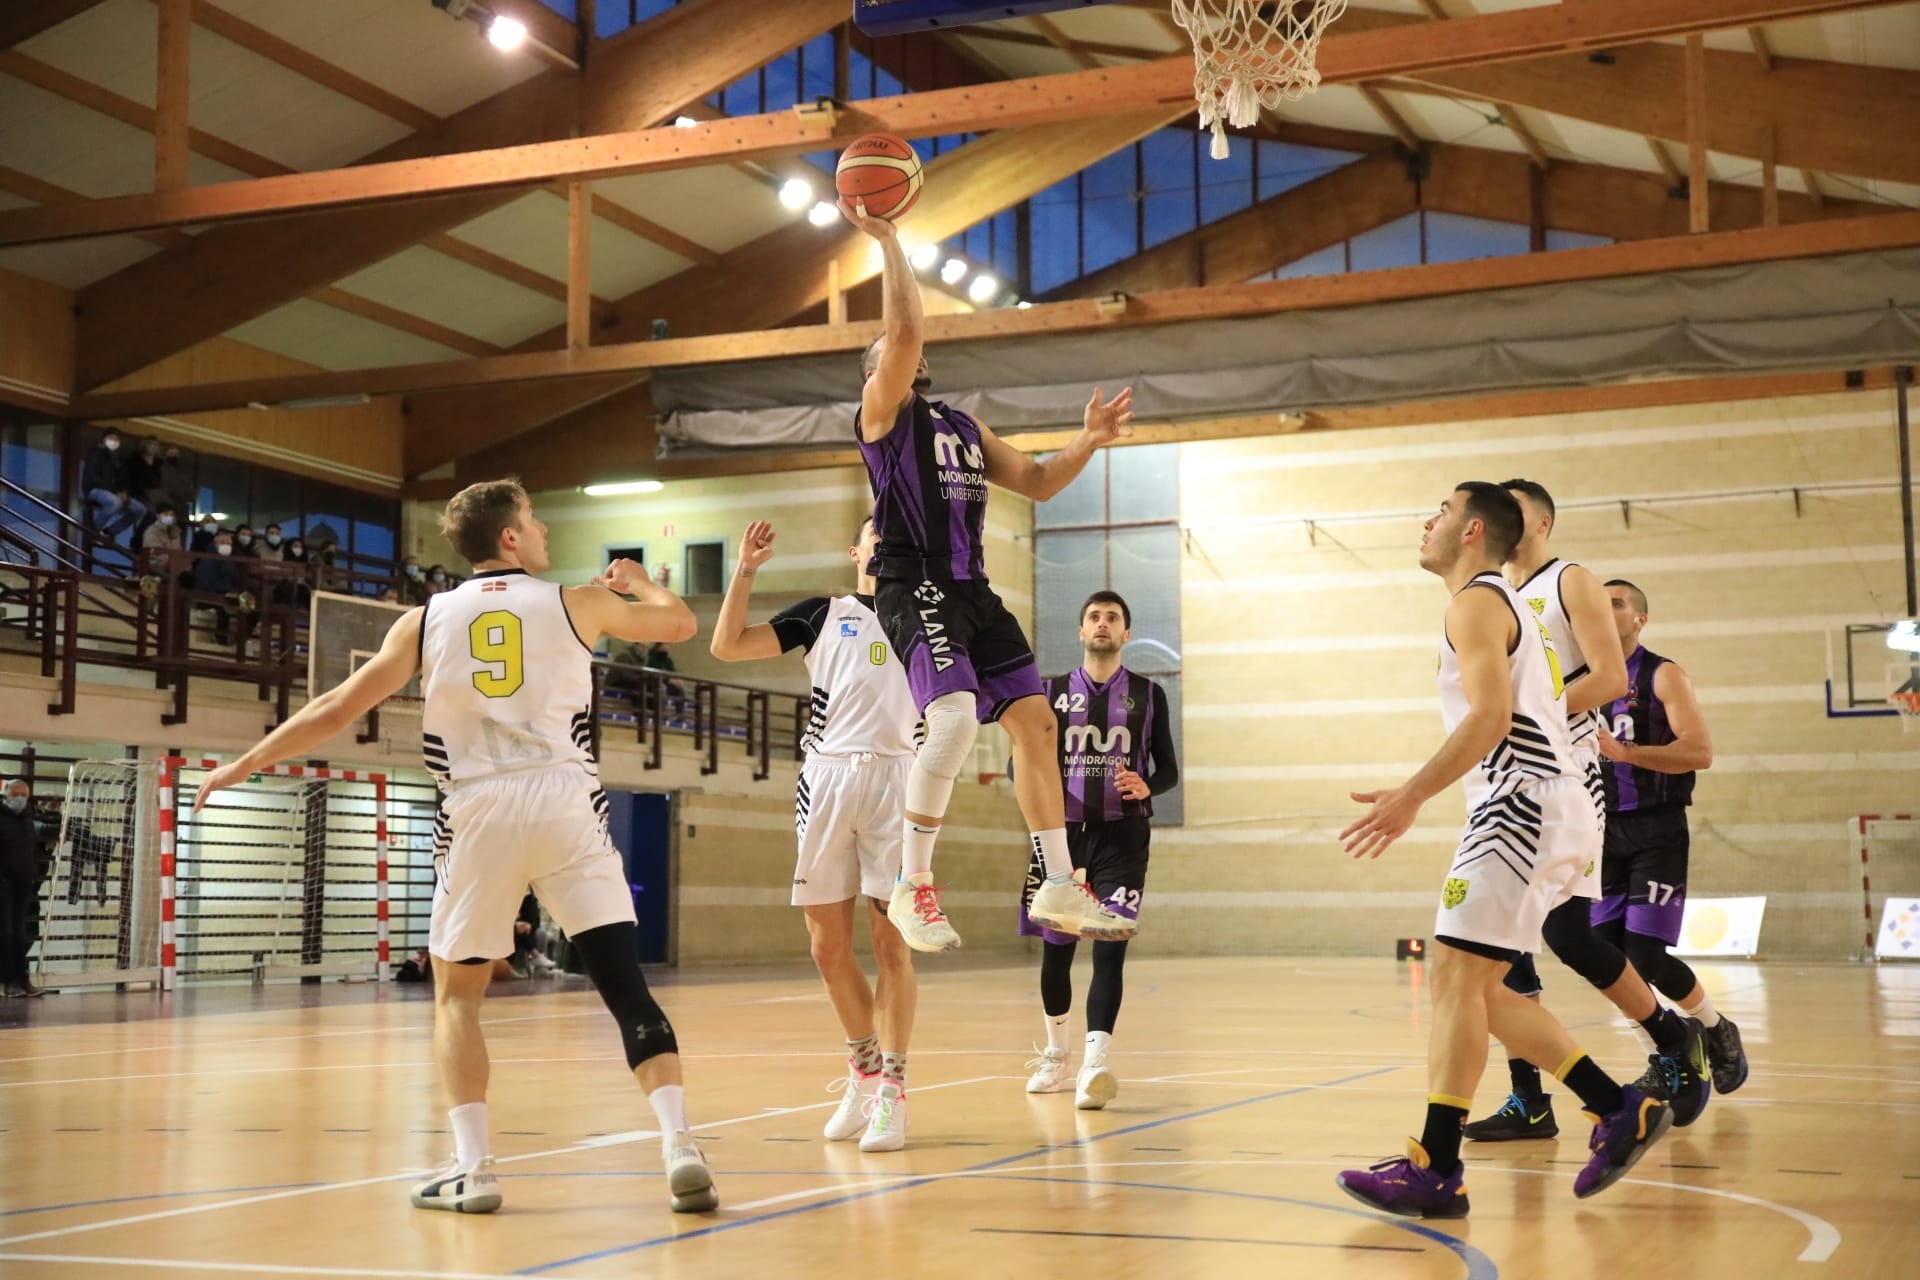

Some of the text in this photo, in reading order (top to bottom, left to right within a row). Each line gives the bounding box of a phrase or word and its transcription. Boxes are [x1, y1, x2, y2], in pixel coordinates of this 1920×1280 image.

[938, 471, 985, 486] MONDRA
[919, 608, 955, 673] LANA
[469, 610, 524, 698] 9
[1054, 693, 1086, 713] 42
[1064, 755, 1131, 767] MONDRAGON
[1063, 767, 1119, 778] UNIBERTSITAT
[1110, 886, 1140, 912] 42
[1647, 880, 1674, 906] 17
[473, 1173, 498, 1186] PUM
